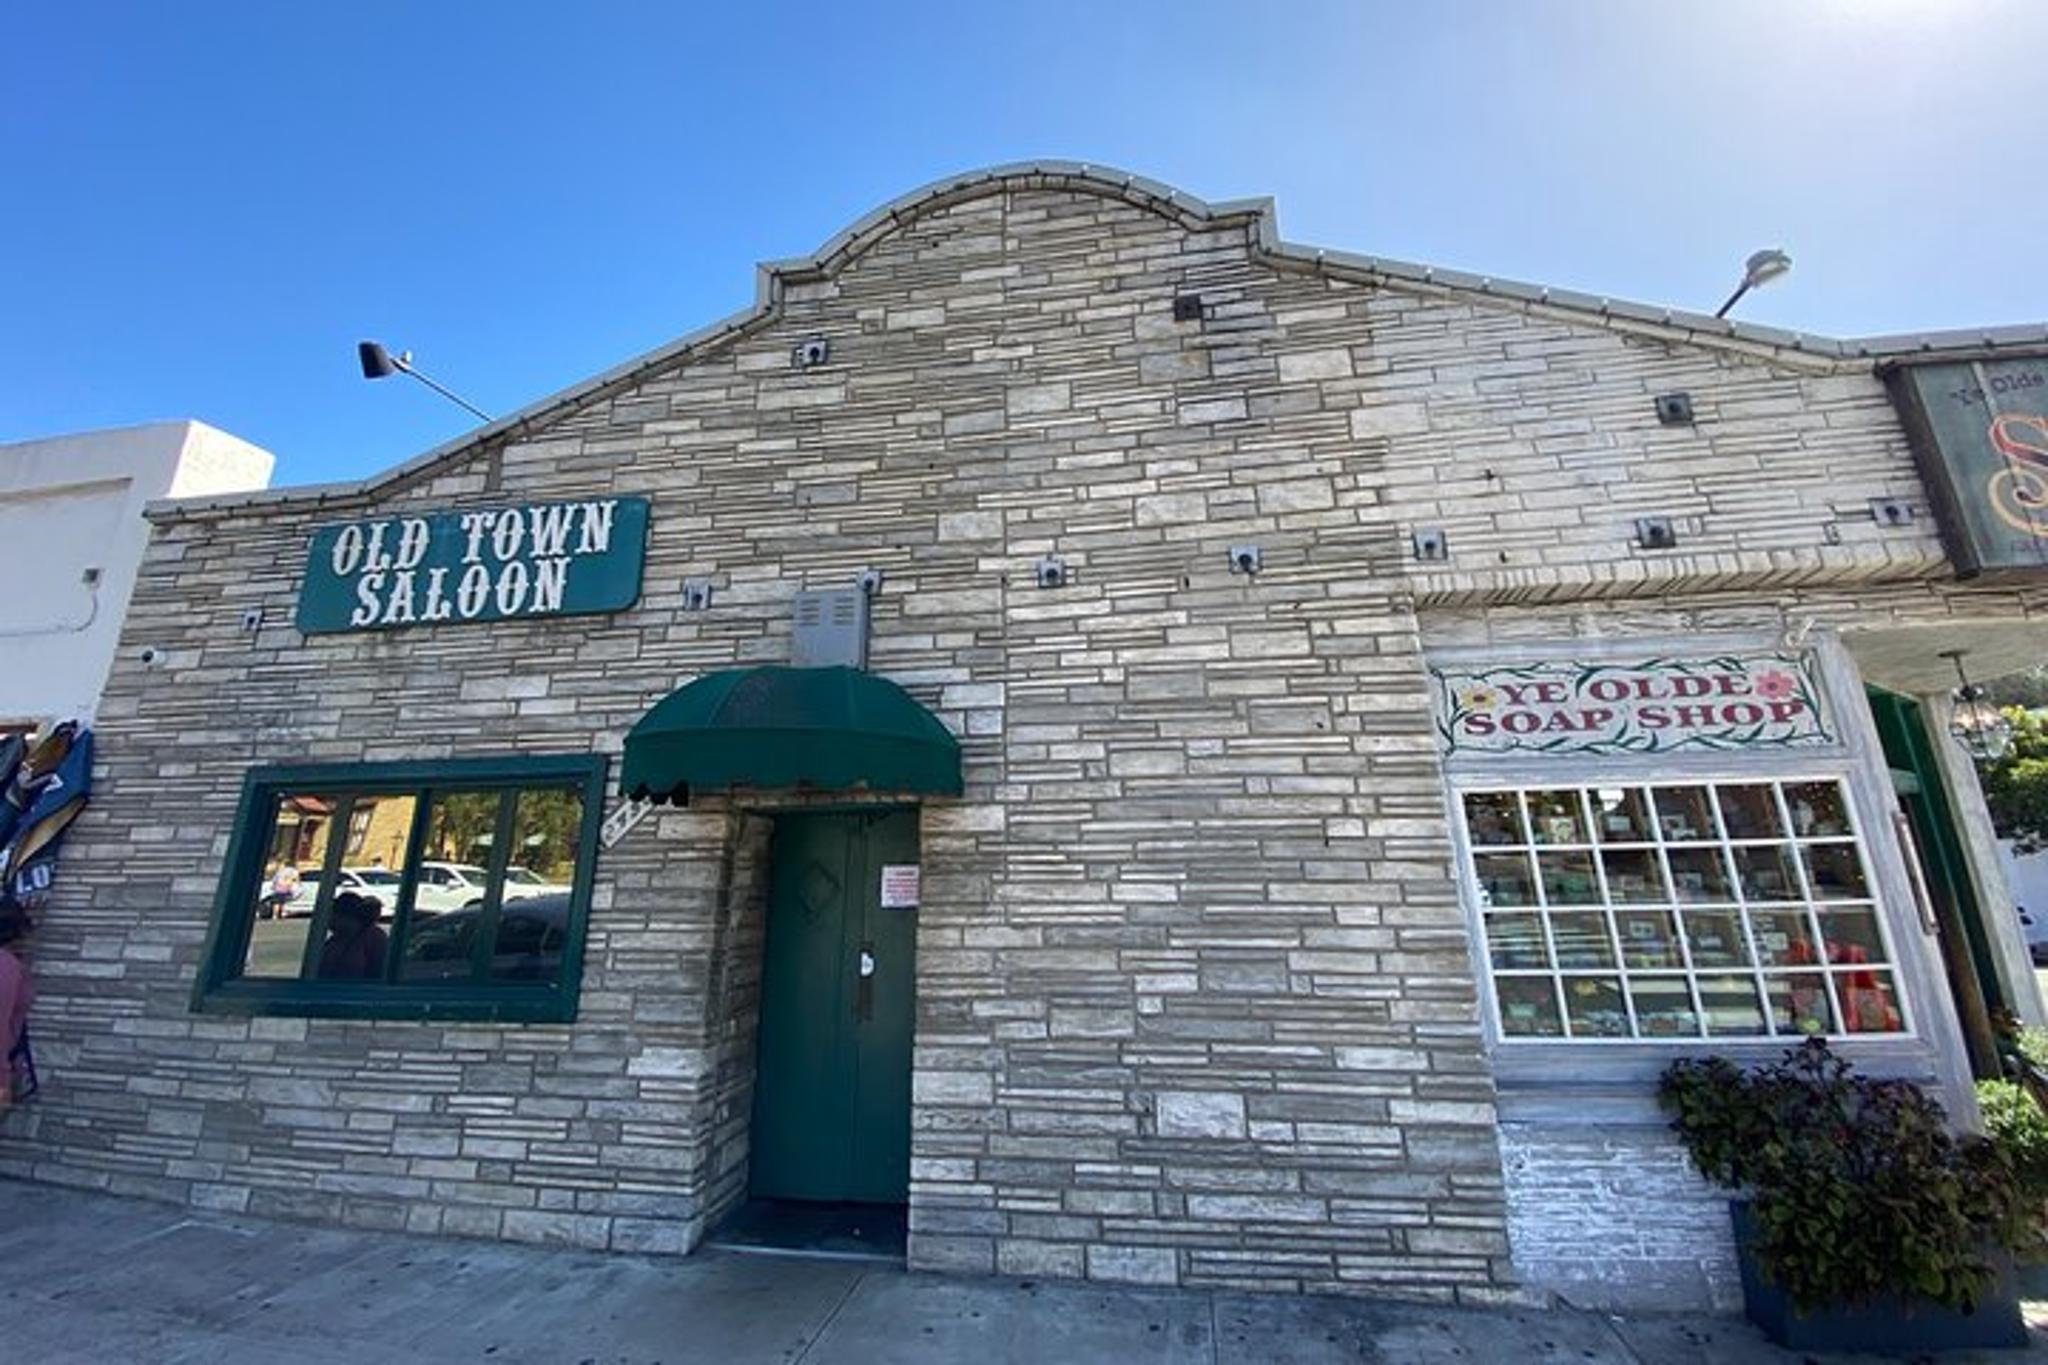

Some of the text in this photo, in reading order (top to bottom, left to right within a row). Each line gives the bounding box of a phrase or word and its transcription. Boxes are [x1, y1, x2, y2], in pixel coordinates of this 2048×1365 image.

[332, 500, 618, 576] OLD TOWN
[351, 556, 572, 627] SALOON
[1496, 674, 1753, 706] YE OLDE
[1463, 700, 1805, 736] SOAP SHOP
